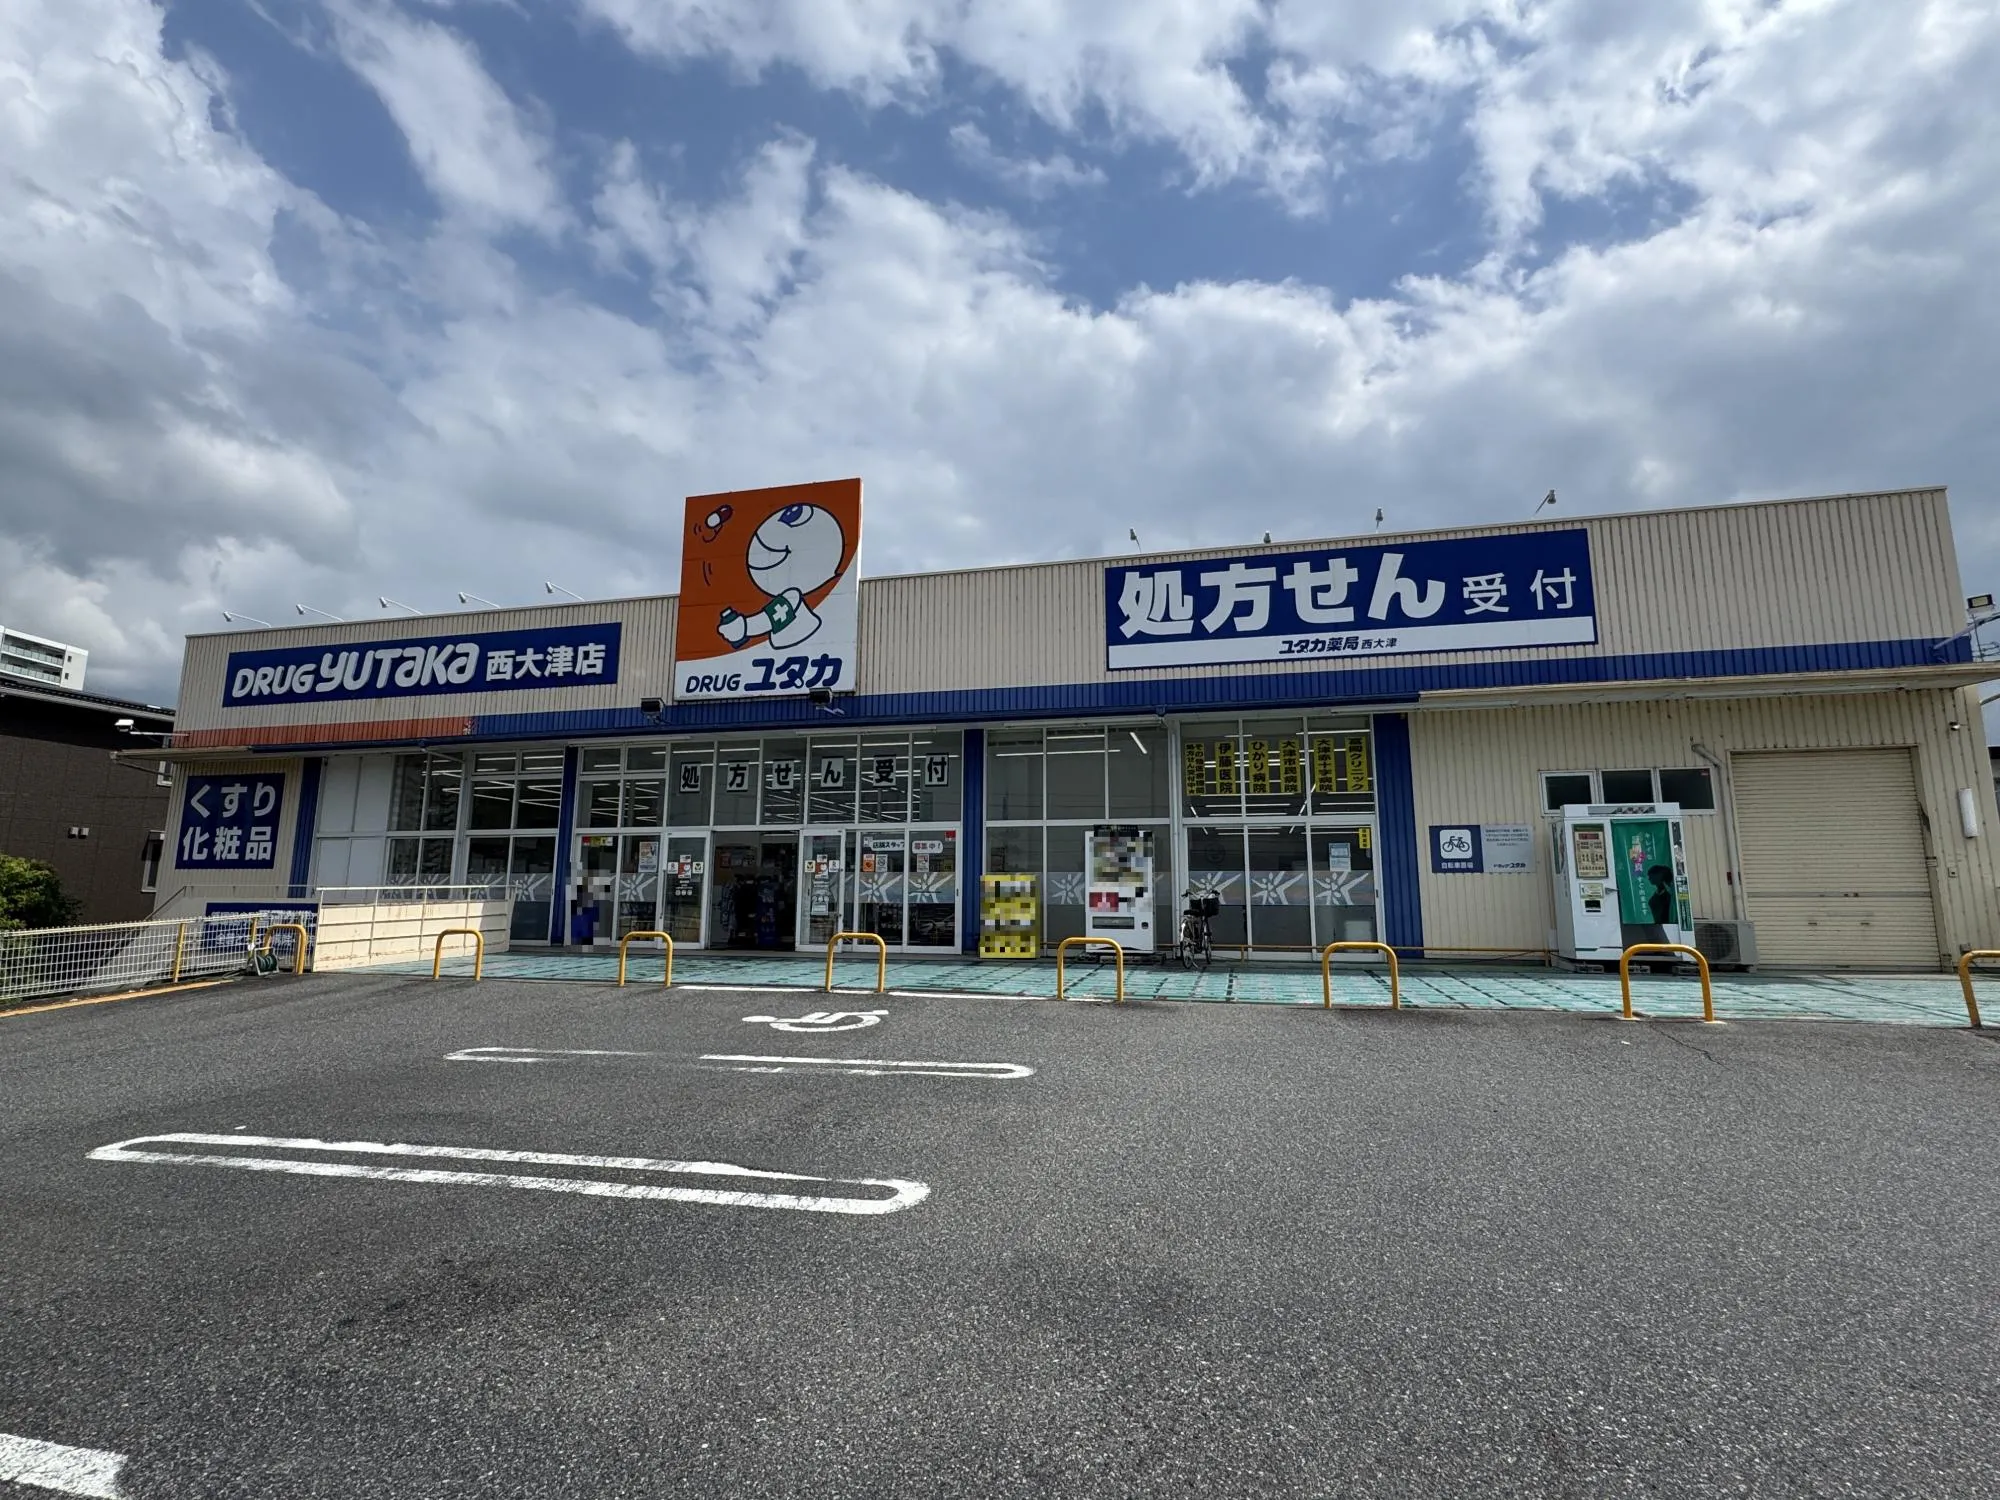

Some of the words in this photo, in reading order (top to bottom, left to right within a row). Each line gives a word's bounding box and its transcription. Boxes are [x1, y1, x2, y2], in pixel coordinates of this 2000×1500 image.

[1118, 552, 1446, 639] 処方せん
[1462, 567, 1578, 615] 受付
[1279, 636, 1360, 655] ユタカ薬局
[1361, 637, 1398, 650] 西大津
[231, 662, 317, 698] DRUG
[486, 642, 607, 682] 西大津店
[685, 673, 741, 693] DRUG
[744, 653, 842, 692] ユタカ
[1251, 741, 1267, 794] ひかり病院
[189, 781, 276, 818] くすり
[182, 826, 272, 862] 化粧品
